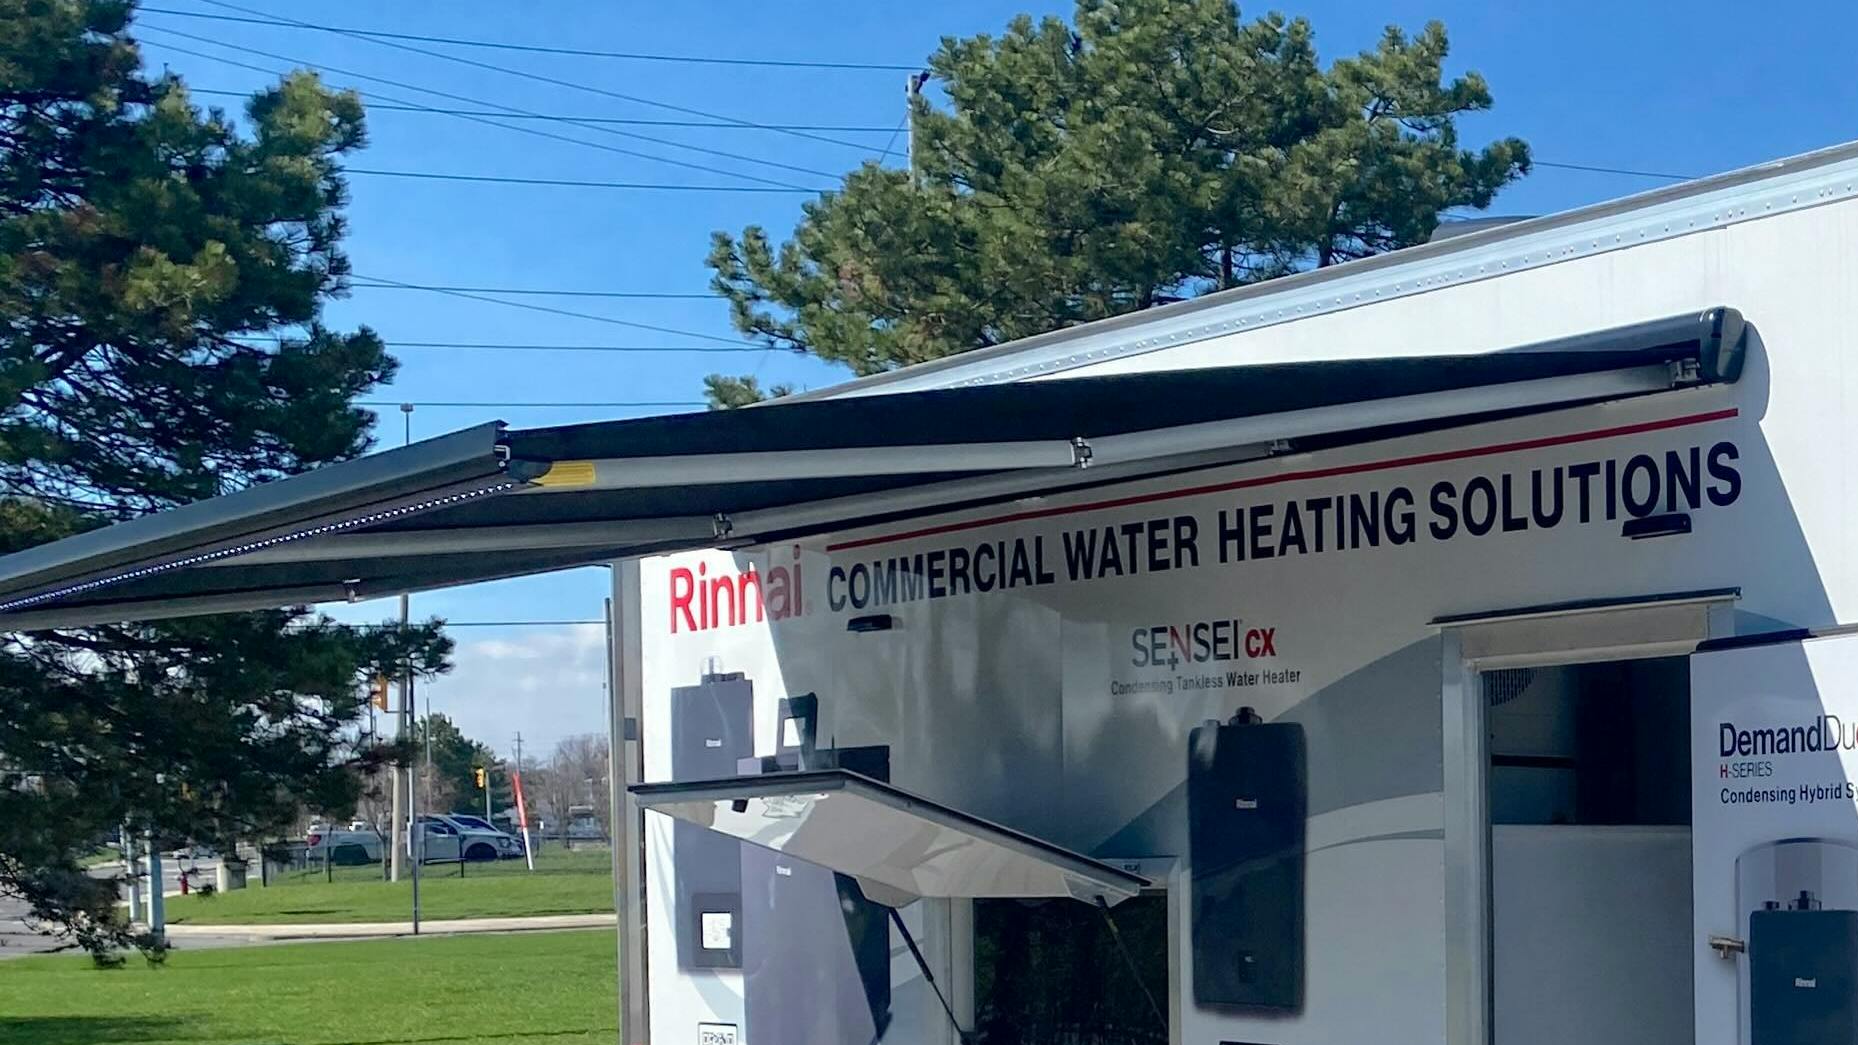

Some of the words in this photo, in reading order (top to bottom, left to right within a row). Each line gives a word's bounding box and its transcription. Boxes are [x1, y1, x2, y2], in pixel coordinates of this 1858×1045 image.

[827, 536, 1055, 612] COMMERCIAL
[1063, 515, 1200, 582] WATER
[1218, 487, 1416, 564] HEATING
[1428, 441, 1743, 540] SOLUTIONS
[670, 544, 803, 634] Rinnai
[1132, 619, 1239, 670] SENSEI
[1176, 674, 1224, 690] Tankless
[1226, 671, 1260, 687] Water
[1262, 669, 1301, 684] Heater
[1720, 761, 1773, 779] H-SERIES
[1721, 788, 1796, 805] Condensing
[1800, 783, 1842, 804] Hybrid
